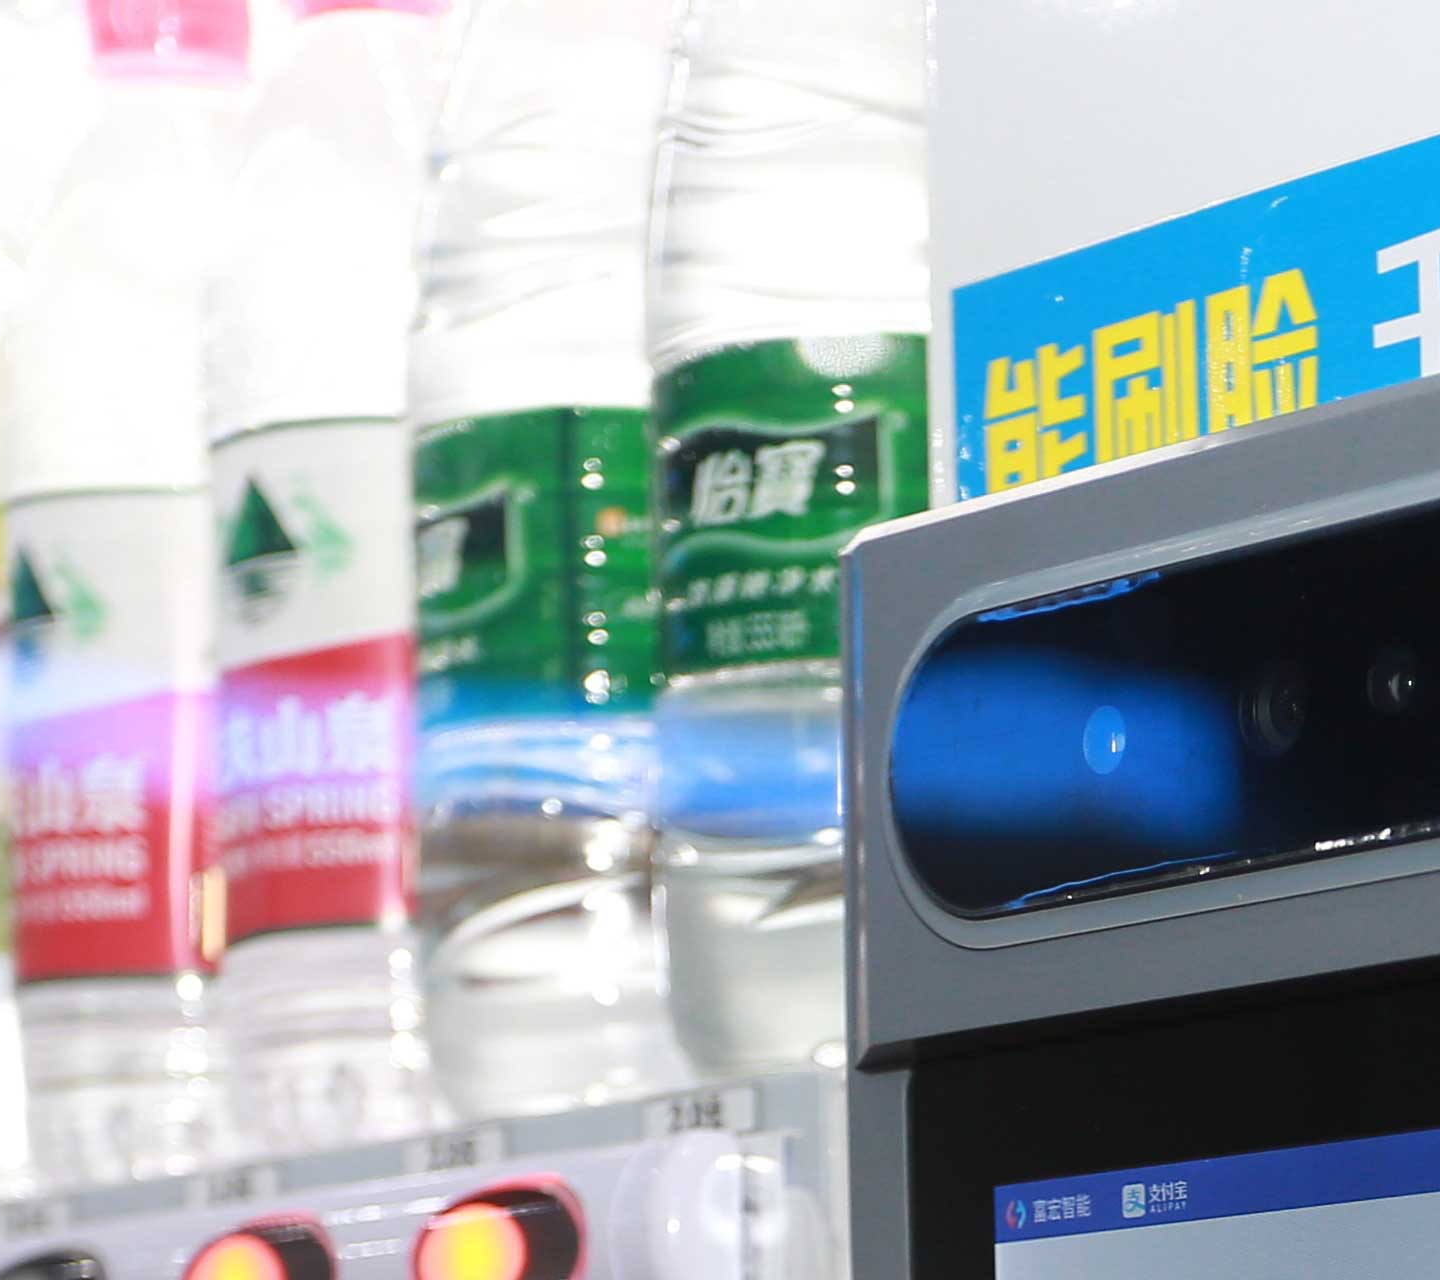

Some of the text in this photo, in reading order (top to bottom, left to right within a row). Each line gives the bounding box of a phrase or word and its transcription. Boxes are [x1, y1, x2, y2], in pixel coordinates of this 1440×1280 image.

[984, 268, 1318, 494] 能刷脸
[1147, 1181, 1188, 1203] 支付宝
[1032, 1194, 1093, 1224] 富宏智能
